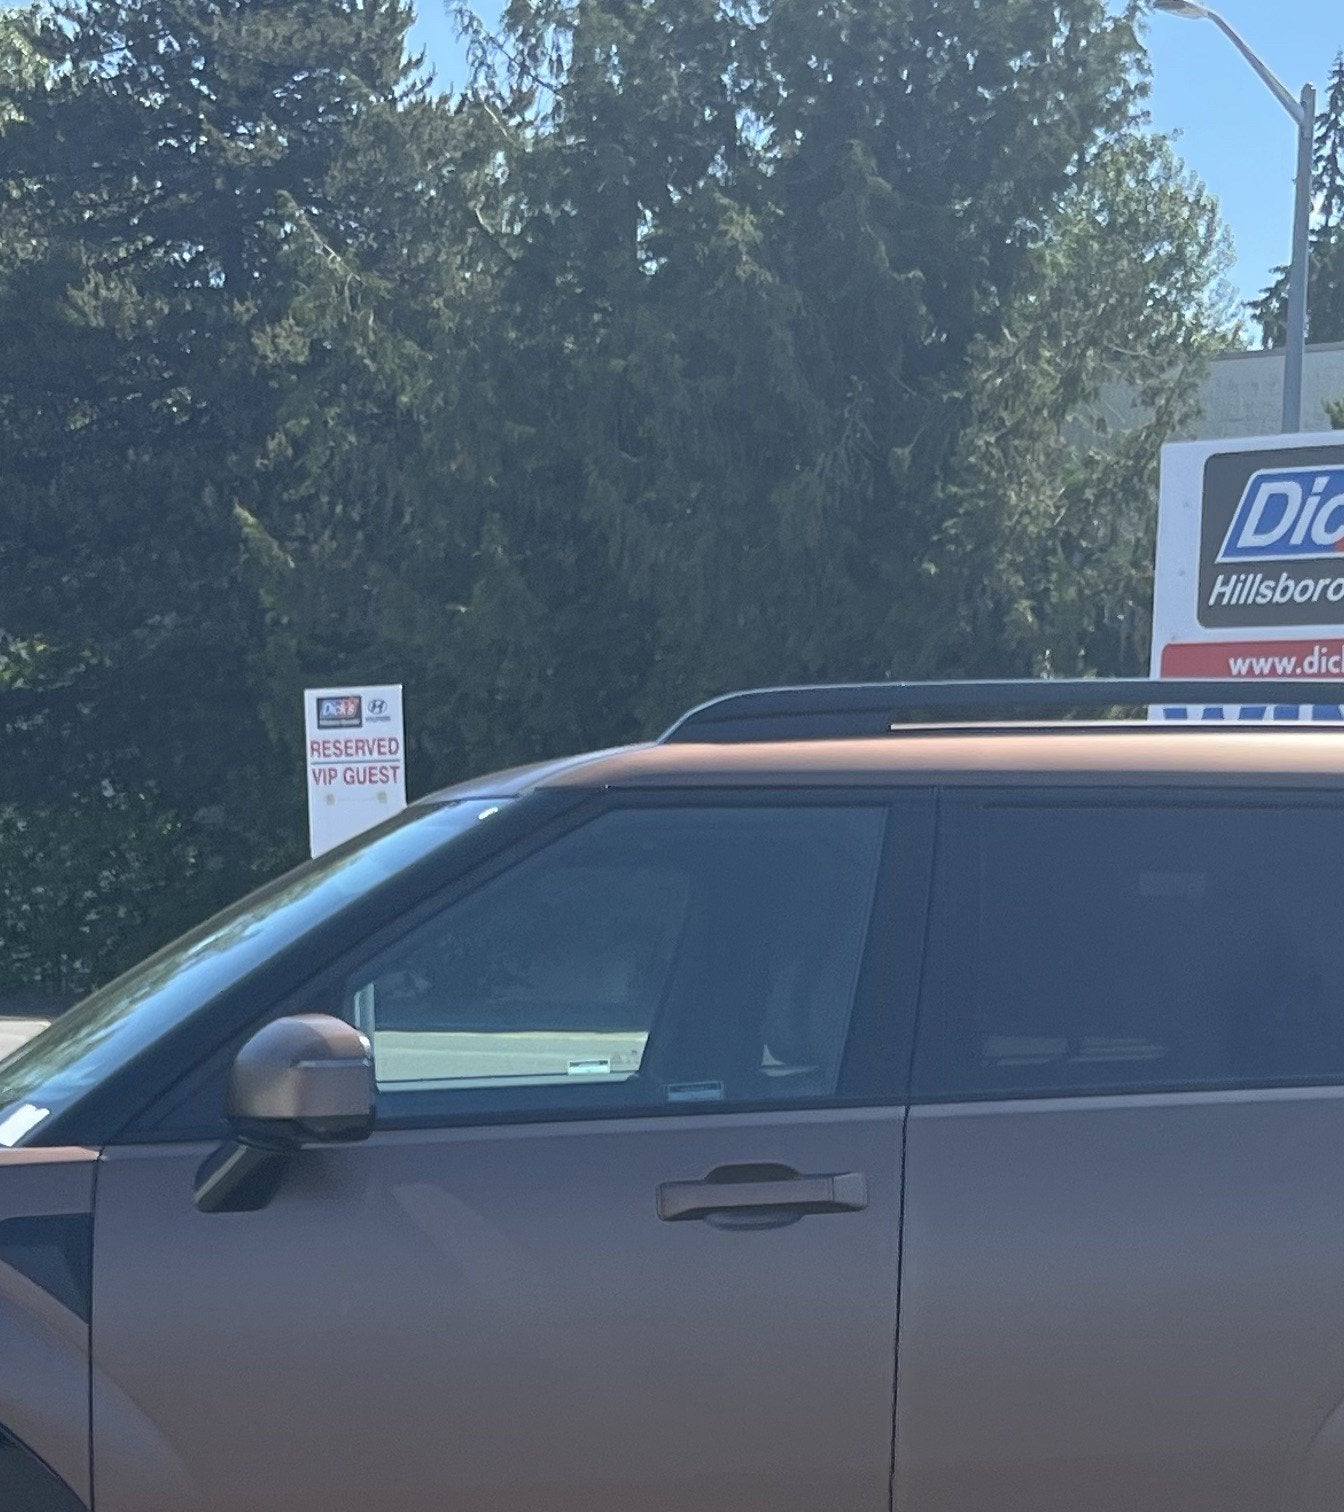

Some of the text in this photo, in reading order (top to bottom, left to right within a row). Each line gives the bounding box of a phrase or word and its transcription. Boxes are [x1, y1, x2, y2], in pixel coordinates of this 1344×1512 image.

[310, 737, 400, 758] RESERVED
[312, 765, 400, 786] VIP GUEST
